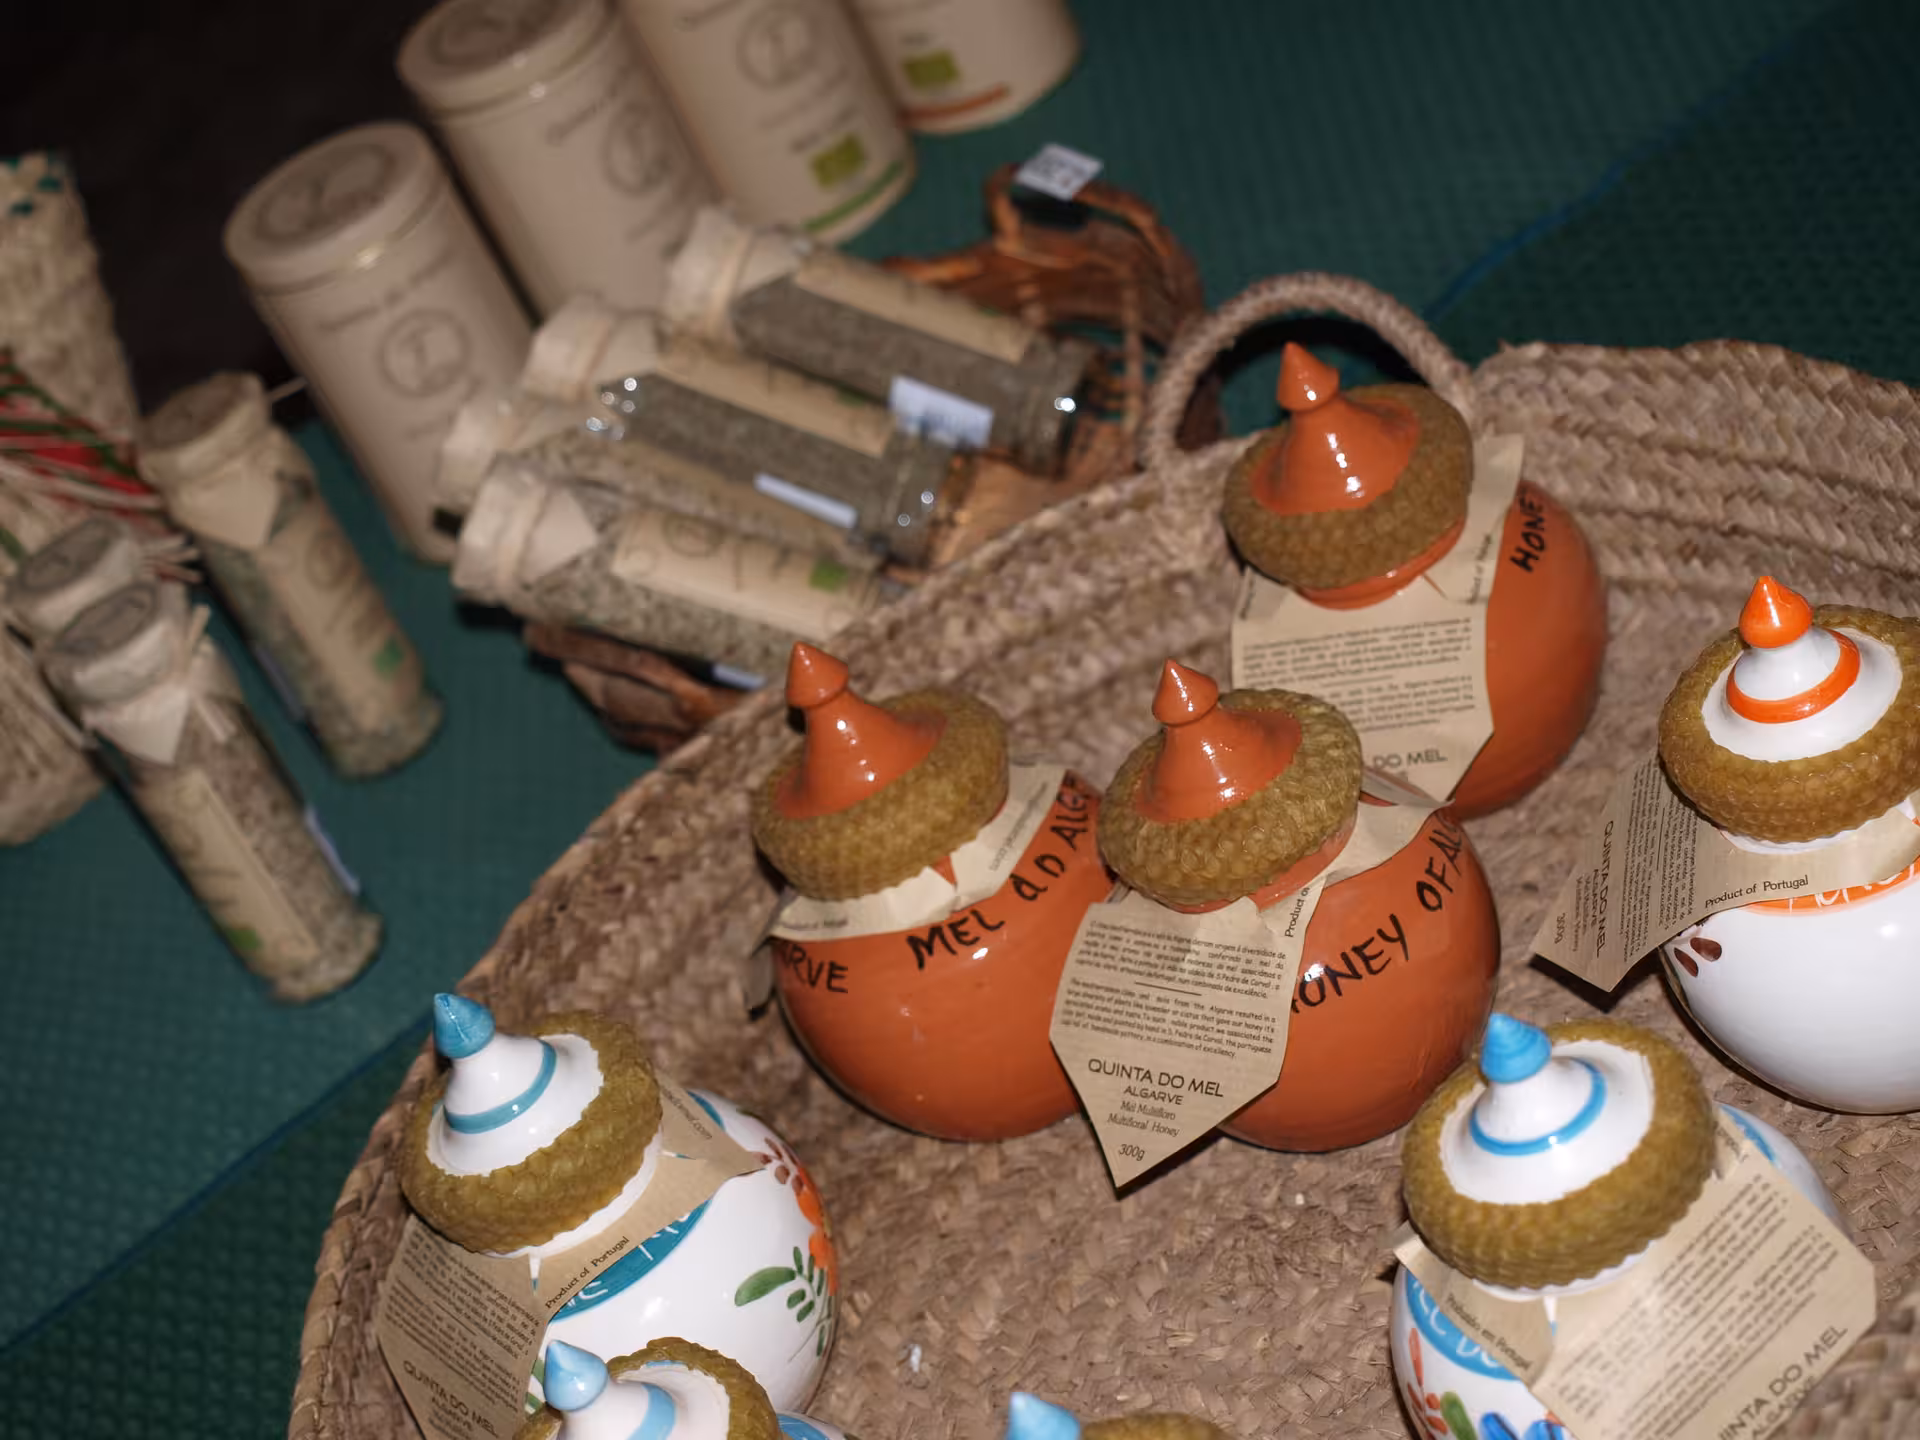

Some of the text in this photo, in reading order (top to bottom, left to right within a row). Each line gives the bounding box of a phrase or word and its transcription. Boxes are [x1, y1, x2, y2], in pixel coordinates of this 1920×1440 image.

[1406, 748, 1448, 767] MEL
[1599, 885, 1609, 915] DO
[1704, 875, 1809, 909] Product of Portugal
[1285, 895, 1304, 938] Product
[906, 909, 1005, 971] MEL
[1596, 917, 1606, 958] MEL
[1088, 1058, 1224, 1098] QUINTA DO MEL
[1124, 1086, 1184, 1105] ALGARVE
[1151, 1123, 1180, 1138] Honey
[1119, 1144, 1145, 1161] 300g
[545, 1236, 630, 1309] Product of Portugal
[1769, 1364, 1802, 1397] DO
[1804, 1326, 1848, 1366] MEL
